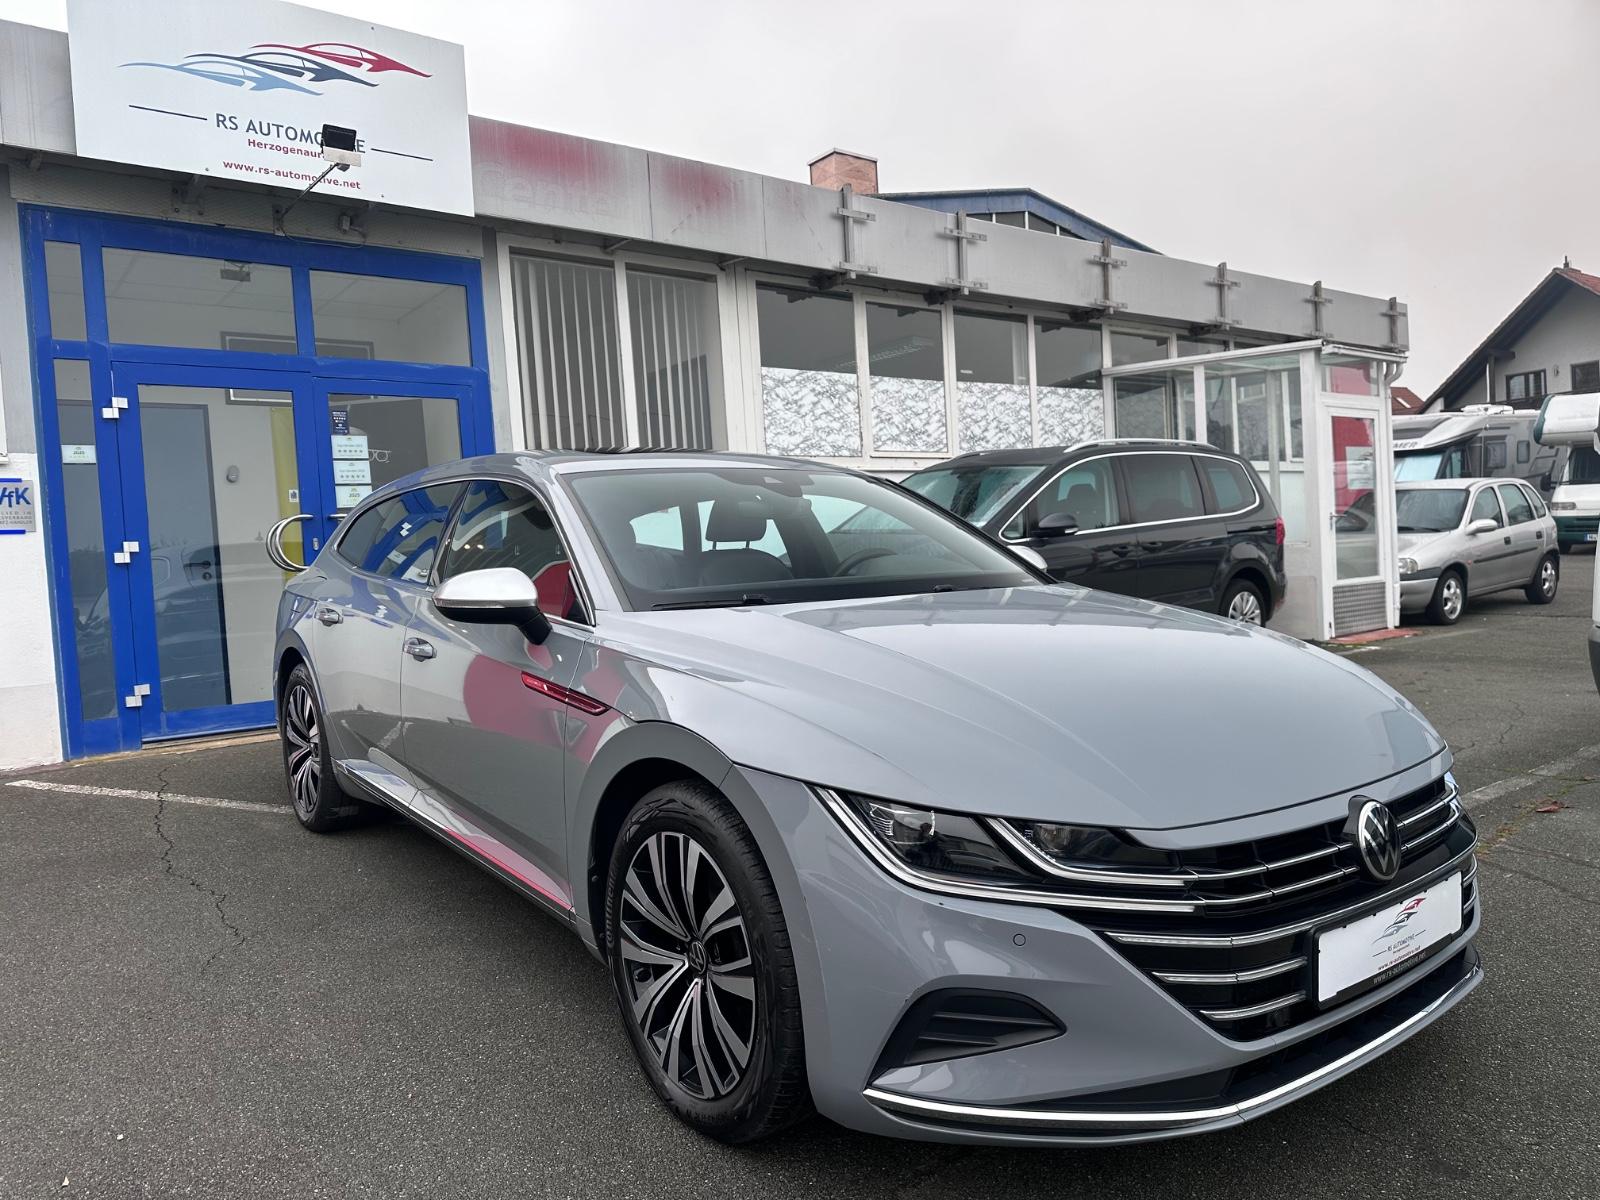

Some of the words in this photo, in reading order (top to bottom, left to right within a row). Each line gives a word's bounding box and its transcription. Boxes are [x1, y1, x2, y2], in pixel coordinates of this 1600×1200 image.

[215, 113, 239, 130] RS
[245, 119, 366, 153] AUTOMOE
[247, 138, 325, 159] Herzogenaur
